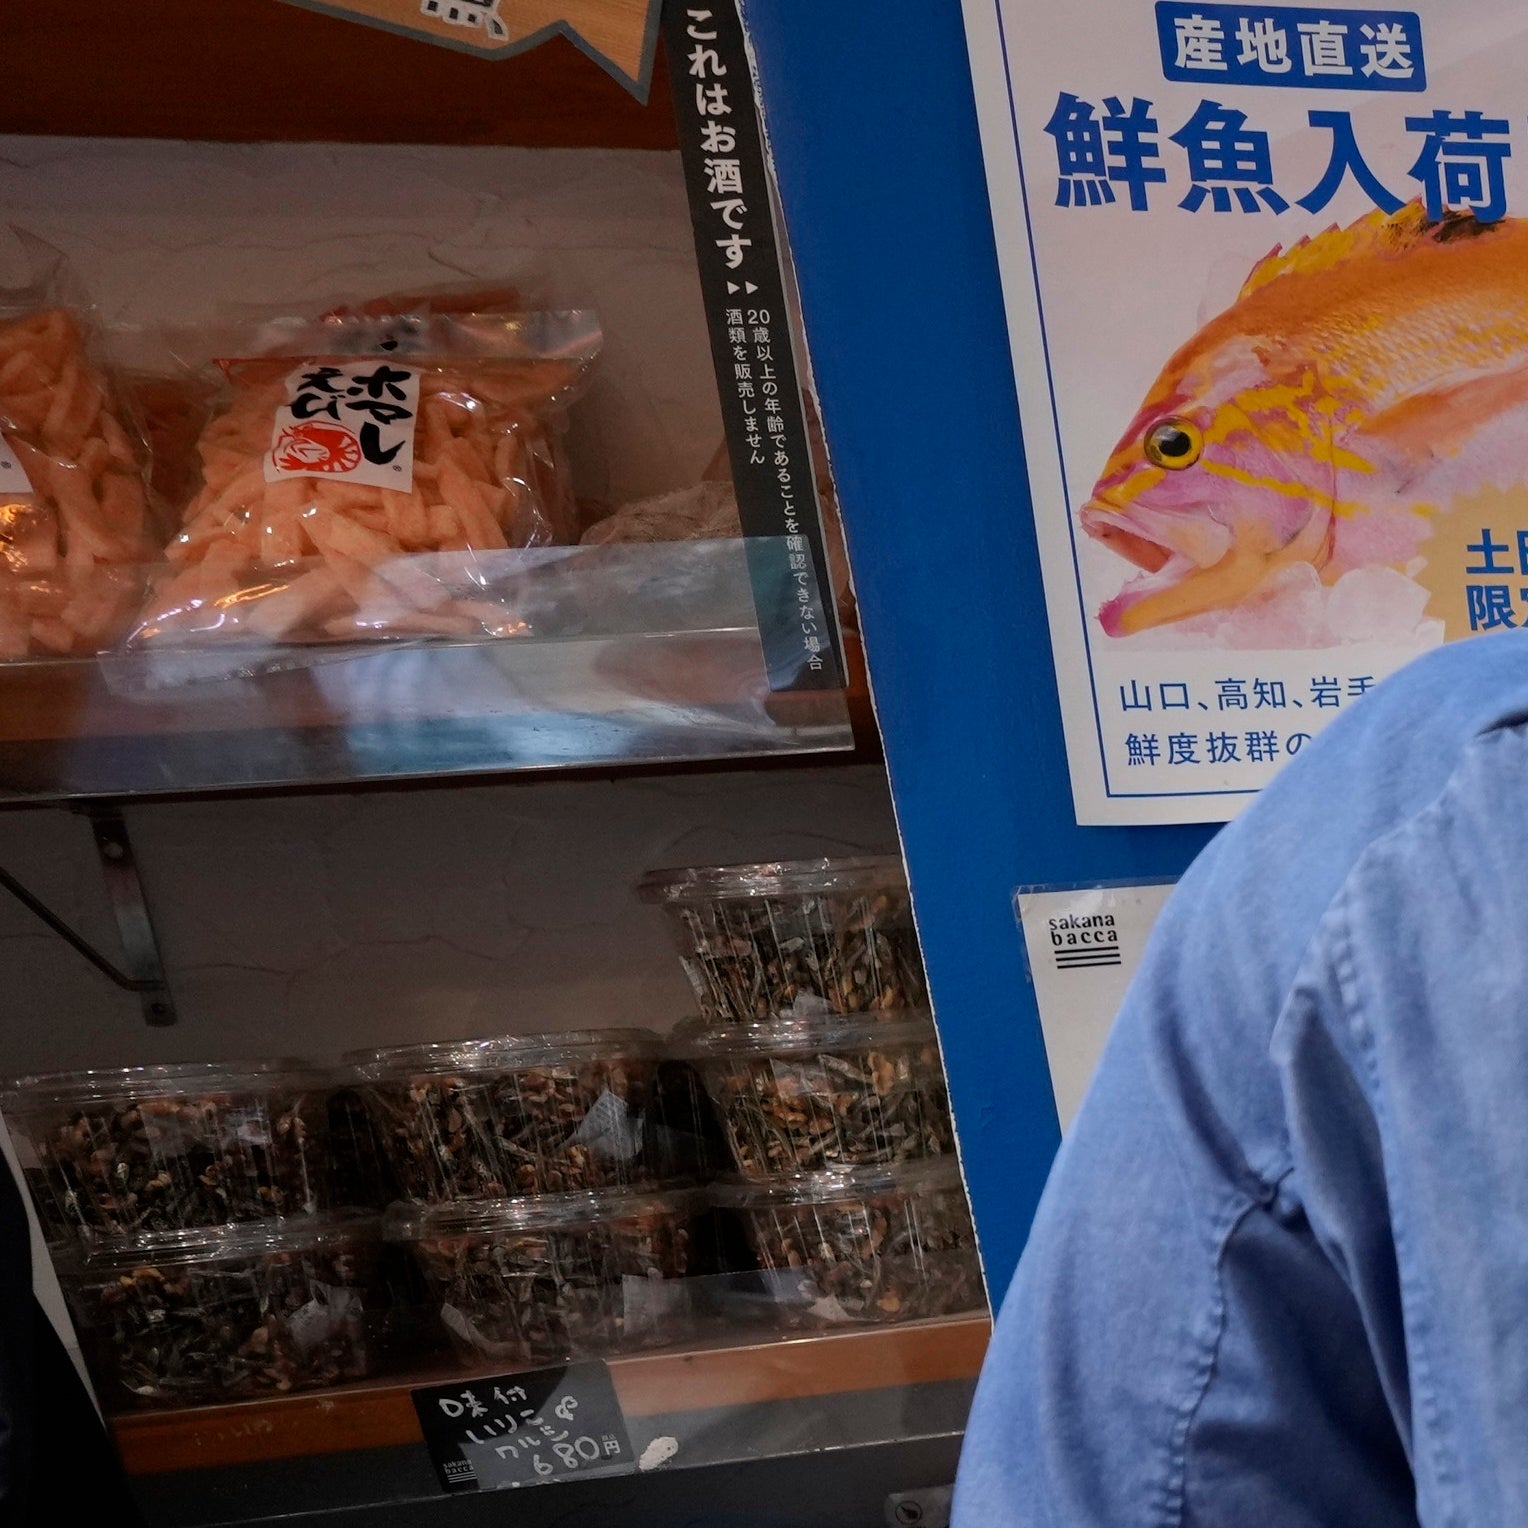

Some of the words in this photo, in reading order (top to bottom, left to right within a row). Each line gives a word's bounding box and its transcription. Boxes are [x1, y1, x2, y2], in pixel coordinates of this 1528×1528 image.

[1174, 14, 1416, 80] 産地直送
[686, 8, 753, 270] これはお酒です
[725, 308, 766, 464] 酒類を販売しません
[747, 308, 823, 671] 20歳以上の年齢であることを確認できない場合
[1125, 730, 1312, 767] 鮮度抜群の
[1049, 914, 1116, 931] sakana
[1050, 927, 1118, 947] bacca
